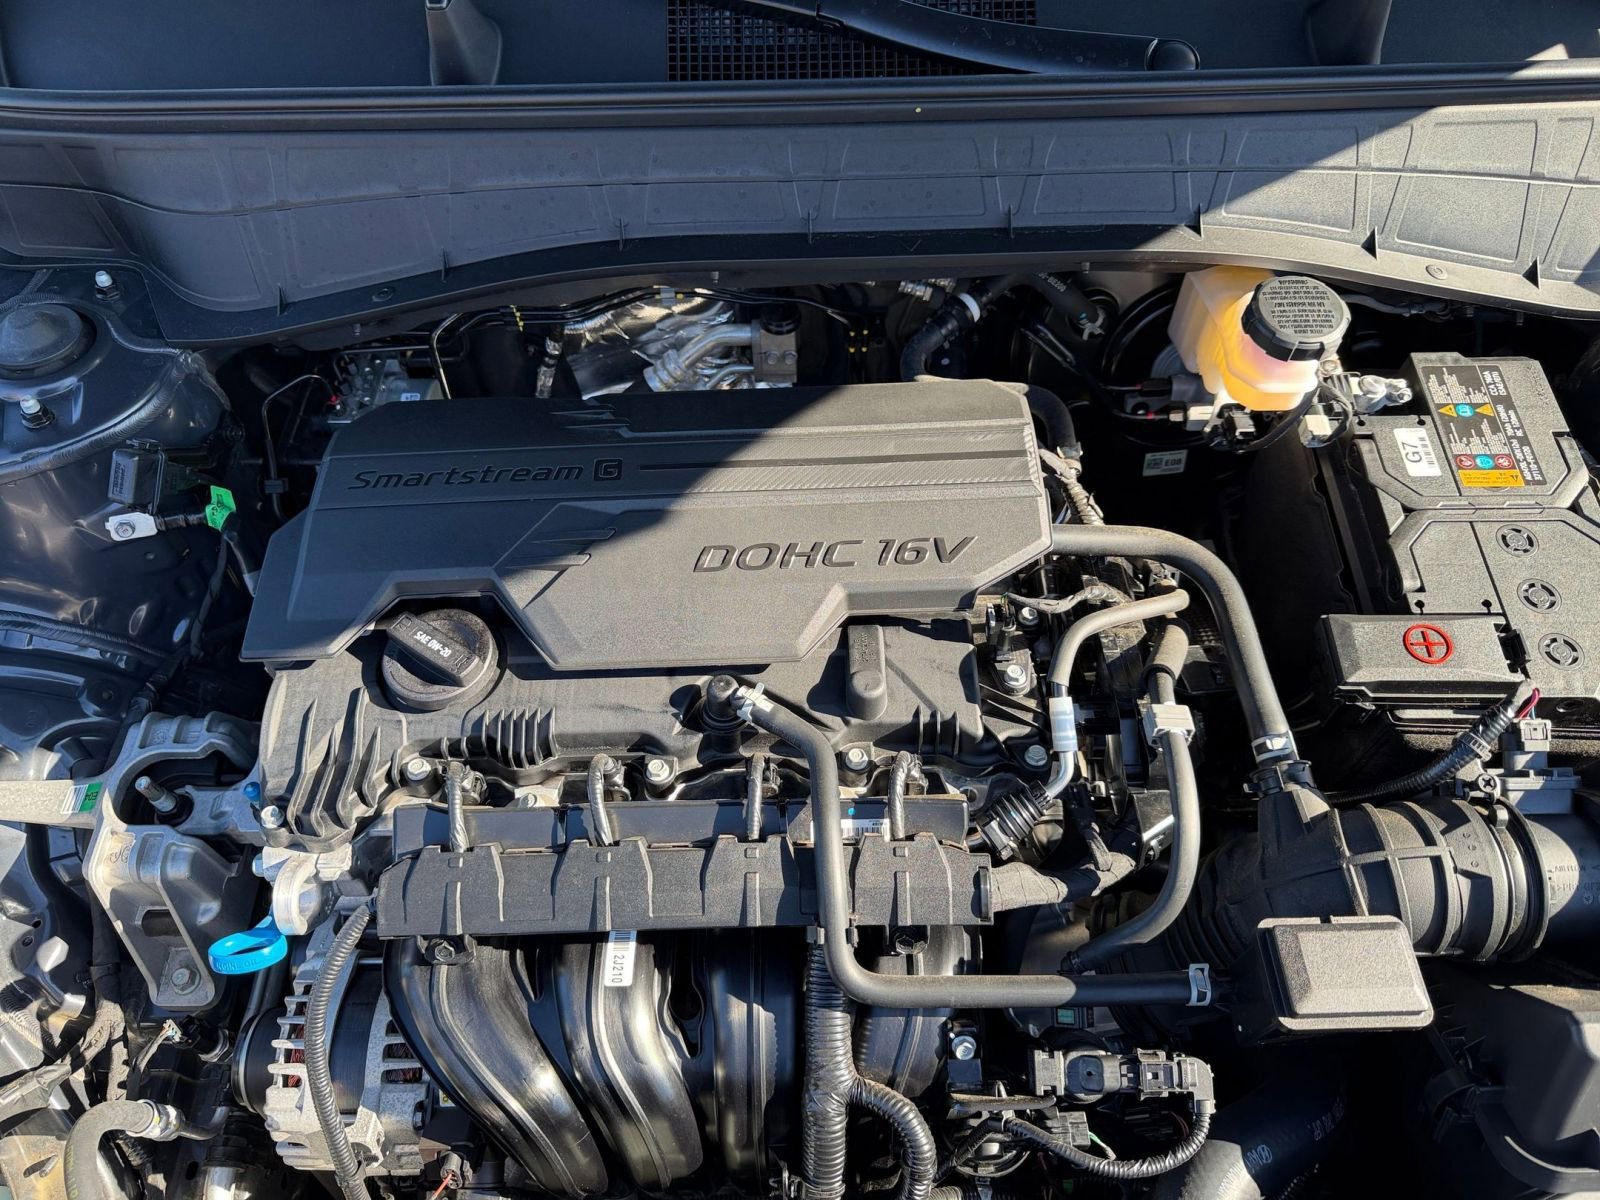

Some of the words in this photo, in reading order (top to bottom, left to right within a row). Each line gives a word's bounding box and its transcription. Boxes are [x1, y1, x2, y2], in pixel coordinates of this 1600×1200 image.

[1488, 384, 1498, 395] CCA
[1514, 428, 1524, 436] RC
[1401, 442, 1423, 463] G7
[348, 463, 584, 490] Smartstream
[595, 459, 622, 480] G
[692, 540, 866, 573] DOHC
[878, 535, 979, 567] 16V
[413, 630, 431, 645] SAE
[427, 640, 453, 658] 0W-20
[611, 954, 625, 984] 2J210
